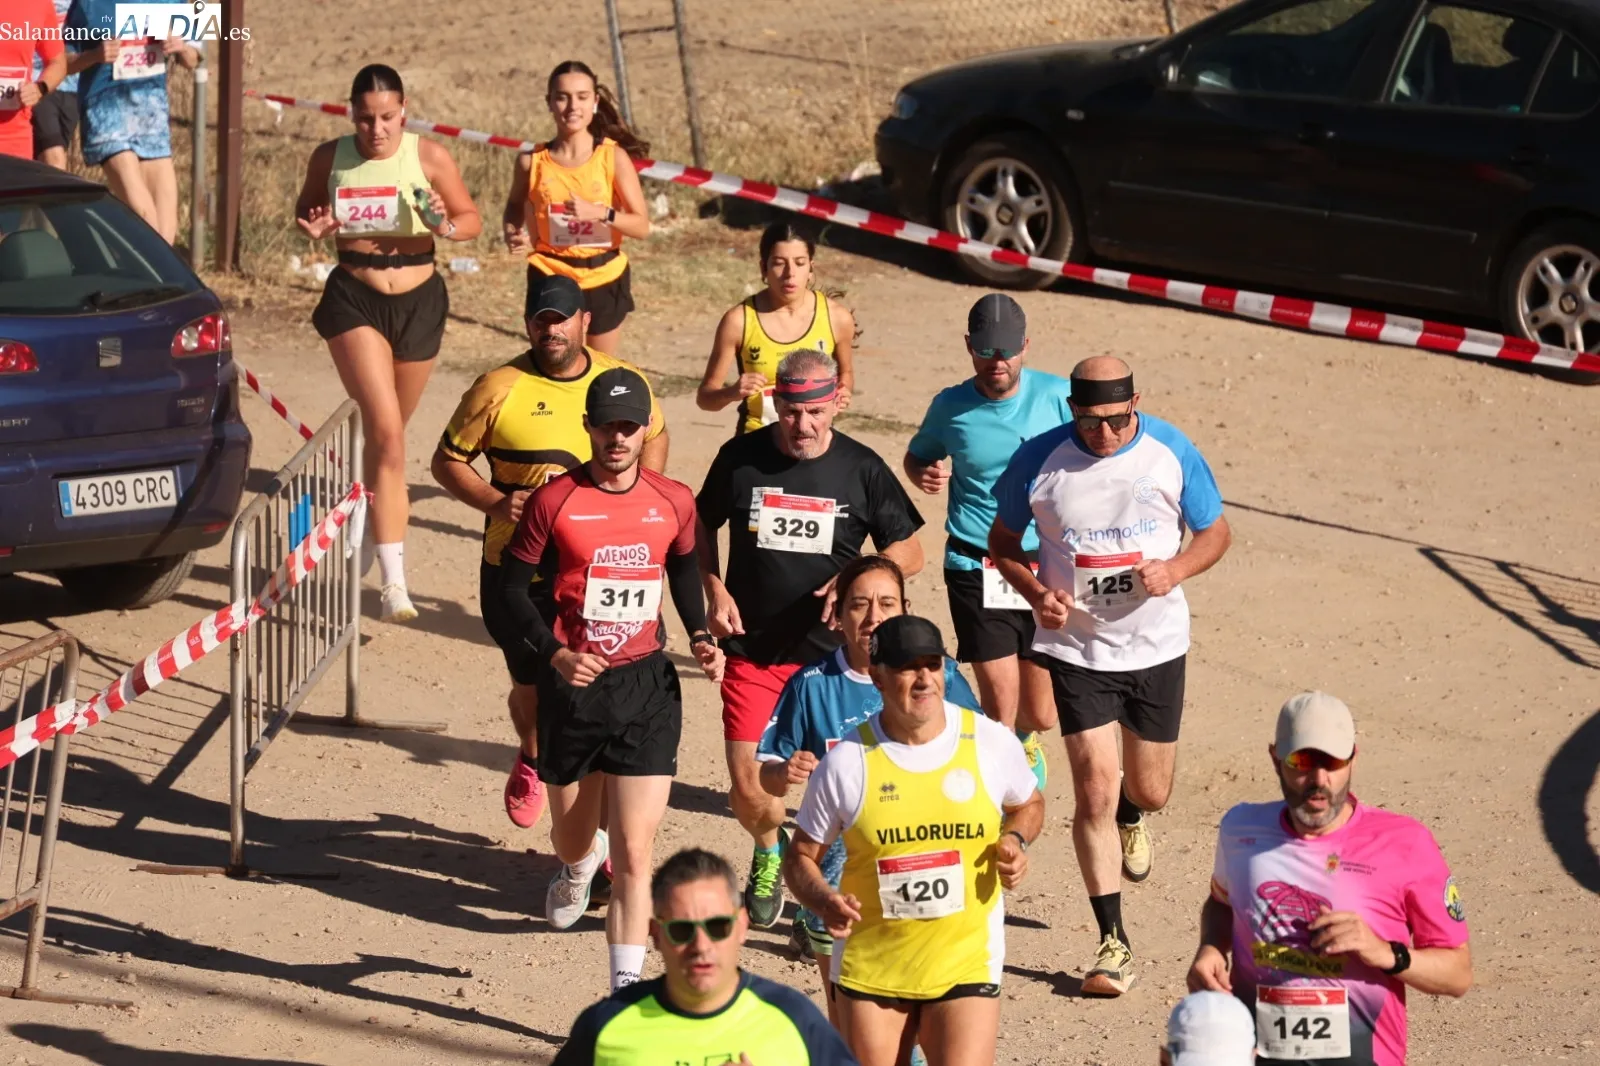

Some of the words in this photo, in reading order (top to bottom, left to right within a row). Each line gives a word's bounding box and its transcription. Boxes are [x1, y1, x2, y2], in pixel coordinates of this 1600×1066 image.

[123, 51, 157, 67] 230
[348, 204, 387, 221] 244
[568, 220, 593, 235] 92
[75, 479, 128, 510] 4309
[133, 475, 171, 504] CRC
[772, 516, 820, 539] 329
[1088, 517, 1158, 541] inmoclip
[596, 546, 647, 564] MENOS
[1087, 574, 1134, 595] 125
[600, 587, 645, 608] 311
[876, 823, 985, 845] VILLORUELA
[896, 878, 949, 902] 120
[1273, 1016, 1332, 1040] 142
